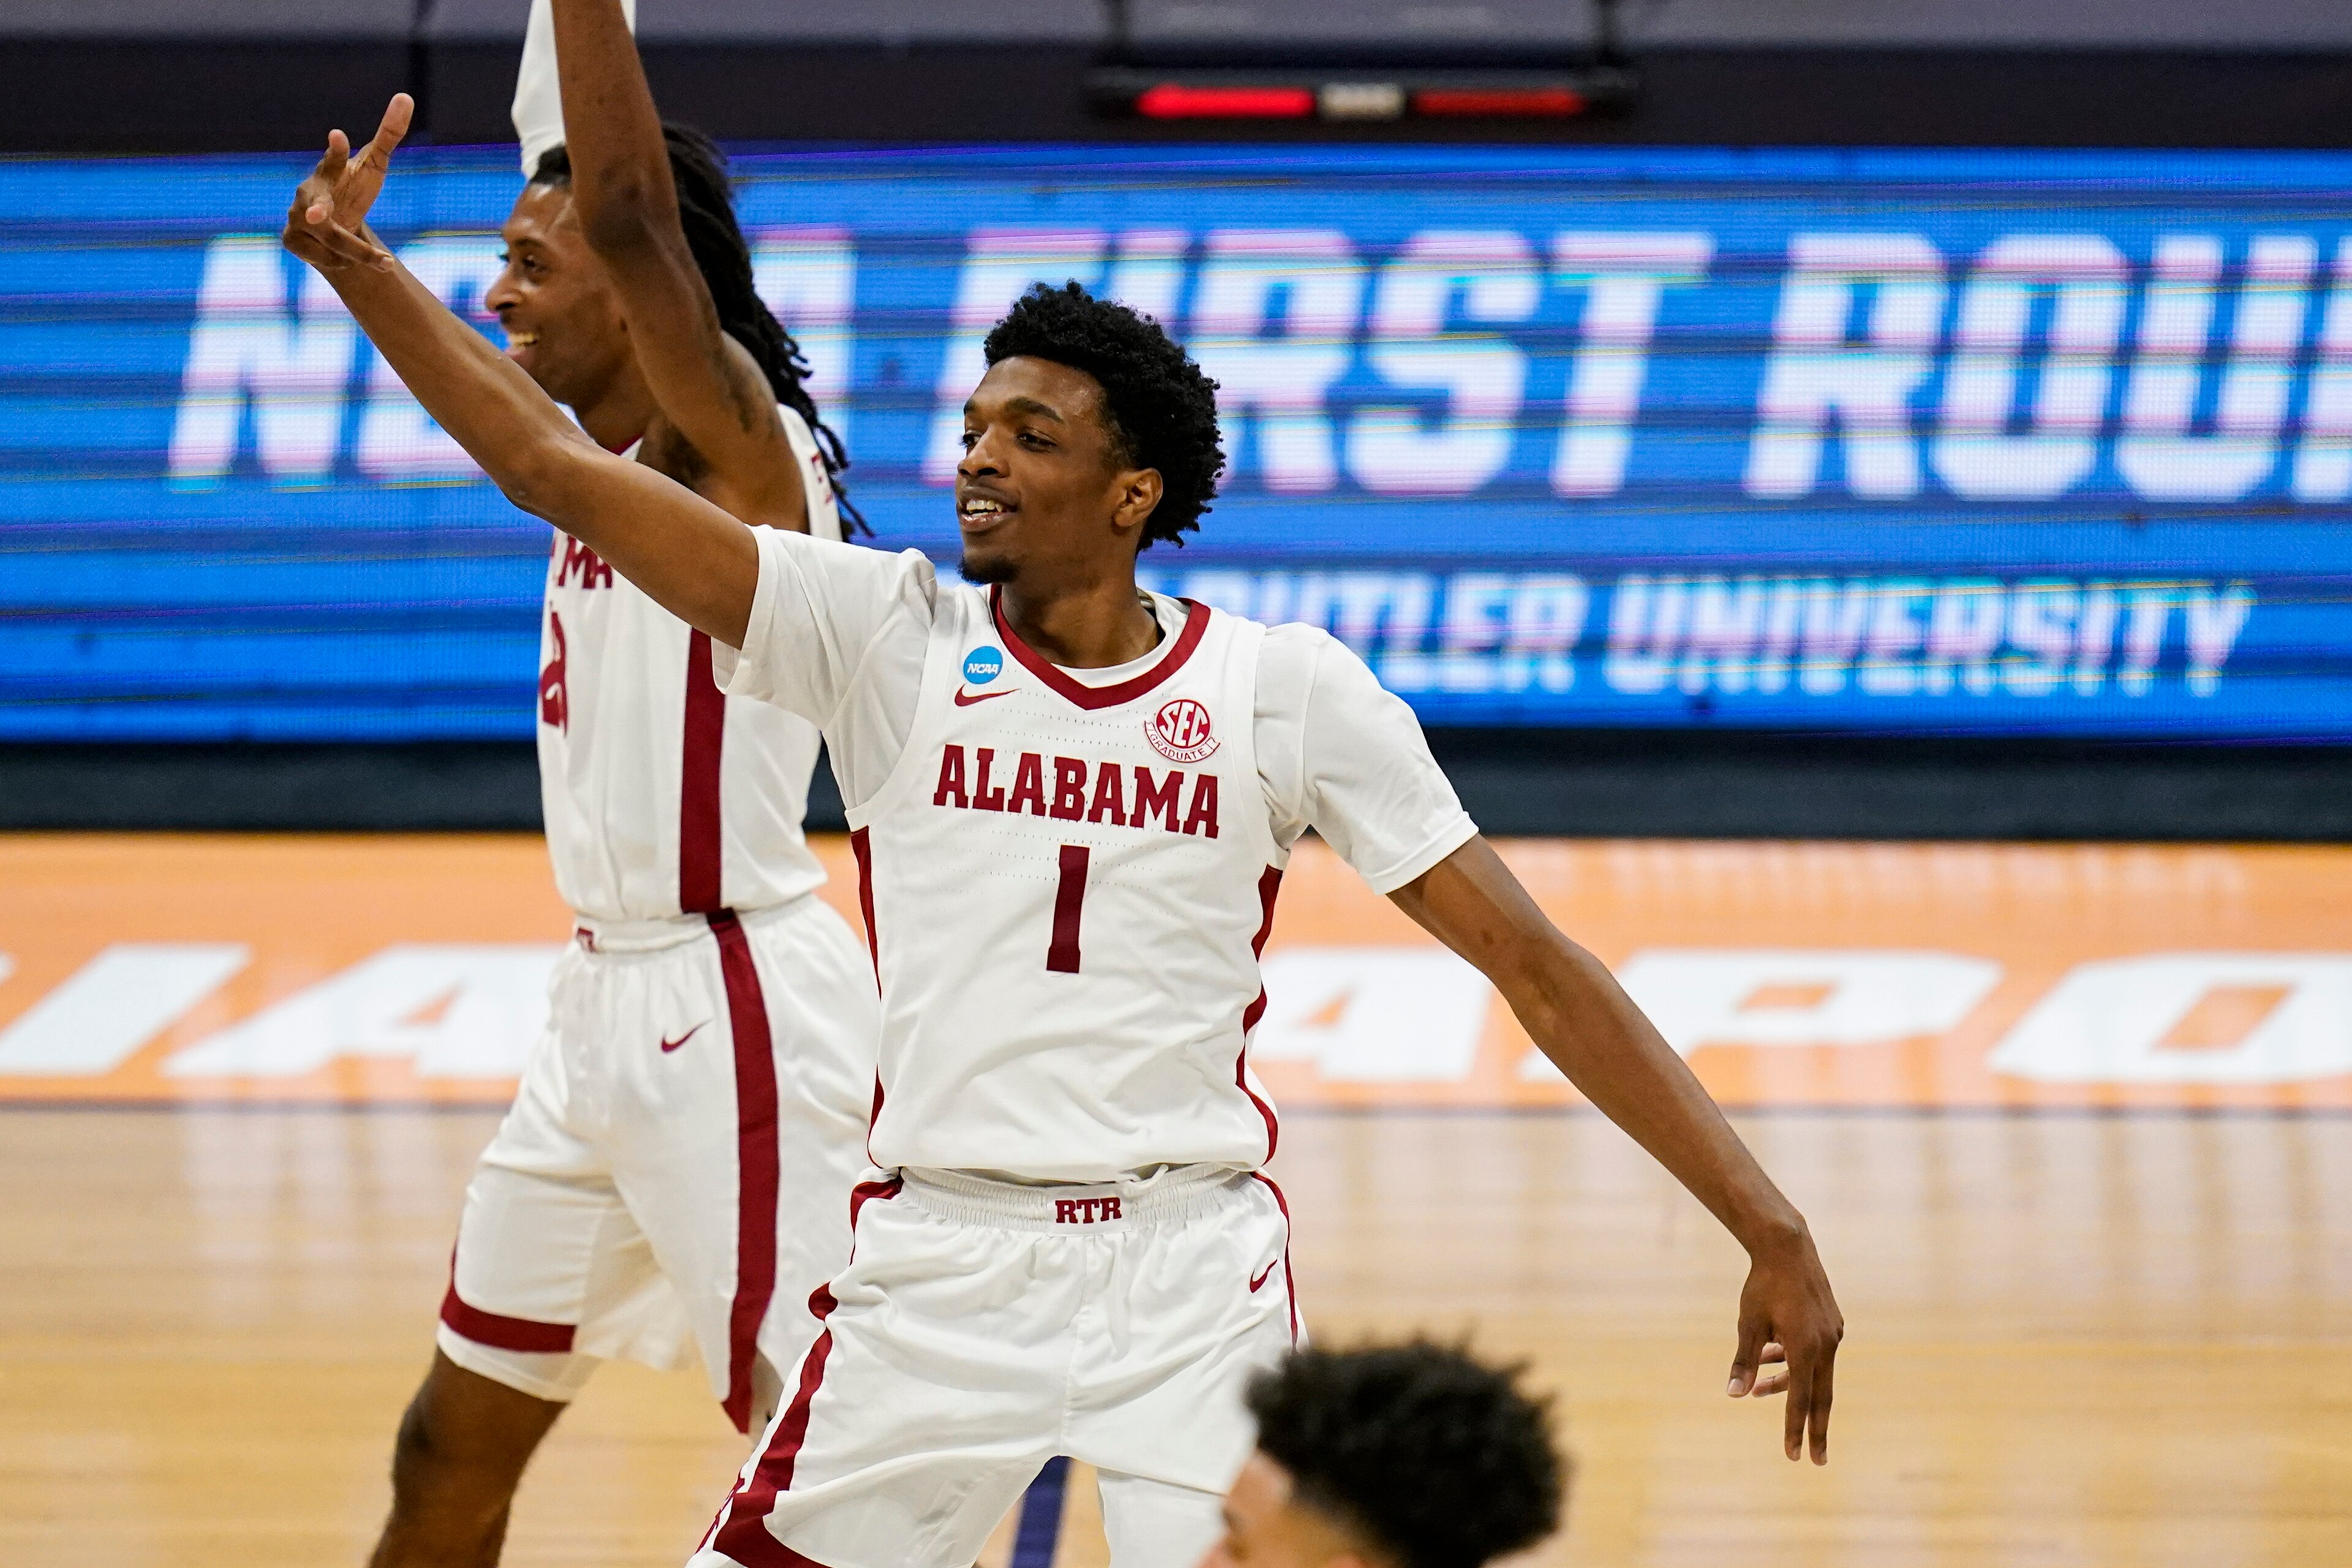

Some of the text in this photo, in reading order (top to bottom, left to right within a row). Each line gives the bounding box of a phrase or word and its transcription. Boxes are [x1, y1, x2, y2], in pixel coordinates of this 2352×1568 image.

[1602, 575, 2258, 697] UNIVERSITY
[967, 663, 1000, 674] NCAA
[1150, 733, 1207, 761] GRADUATE
[1158, 701, 1209, 747] SEC
[933, 744, 1219, 839] ALABAMA
[1046, 844, 1090, 974] 1
[1055, 1197, 1122, 1224] RTR
